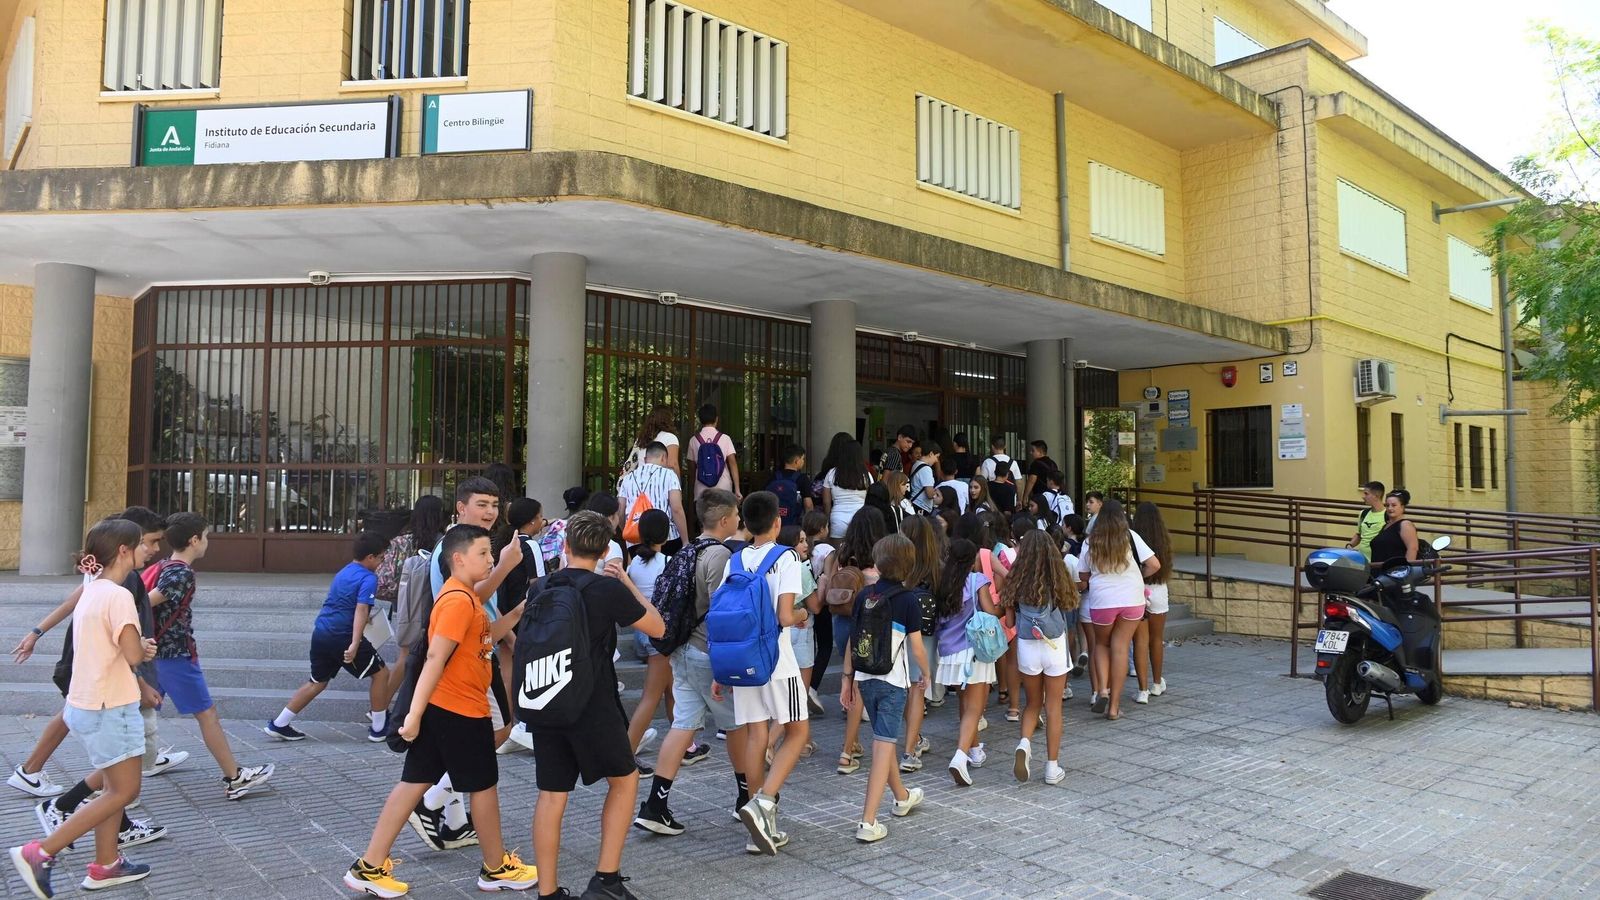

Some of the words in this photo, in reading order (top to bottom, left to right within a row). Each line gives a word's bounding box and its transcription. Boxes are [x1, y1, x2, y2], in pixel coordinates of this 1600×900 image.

[443, 119, 470, 127] Centro
[472, 117, 505, 126] Bilingüe
[205, 126, 248, 137] Instituto
[250, 126, 263, 136] de
[265, 122, 317, 135] Educación
[319, 120, 376, 133] Secundaria
[204, 141, 230, 149] Fidiana
[1325, 631, 1348, 642] 7842
[525, 647, 572, 693] NIKE
